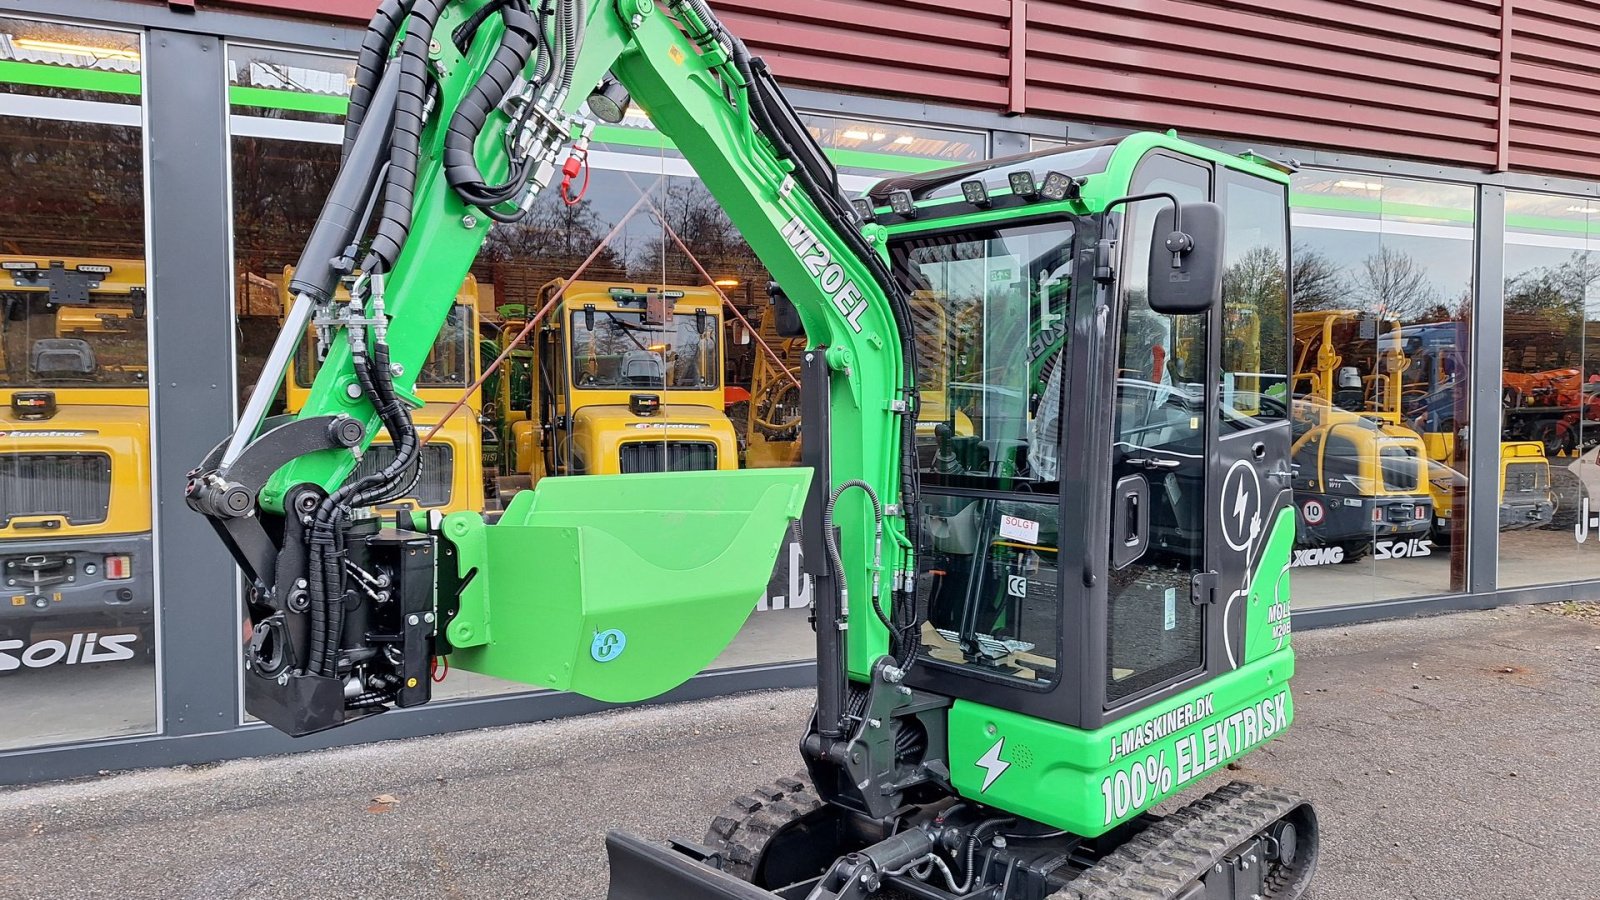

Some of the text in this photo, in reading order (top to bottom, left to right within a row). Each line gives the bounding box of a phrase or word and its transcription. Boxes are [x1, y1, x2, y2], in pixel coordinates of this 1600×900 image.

[780, 215, 869, 334] M20EL
[1005, 517, 1035, 530] SOLGT
[1306, 505, 1320, 517] 10
[1291, 546, 1344, 568] XCMG
[1109, 692, 1214, 763] J-MASKINER.DK
[1101, 690, 1287, 826] 100% ELEKTRISK
